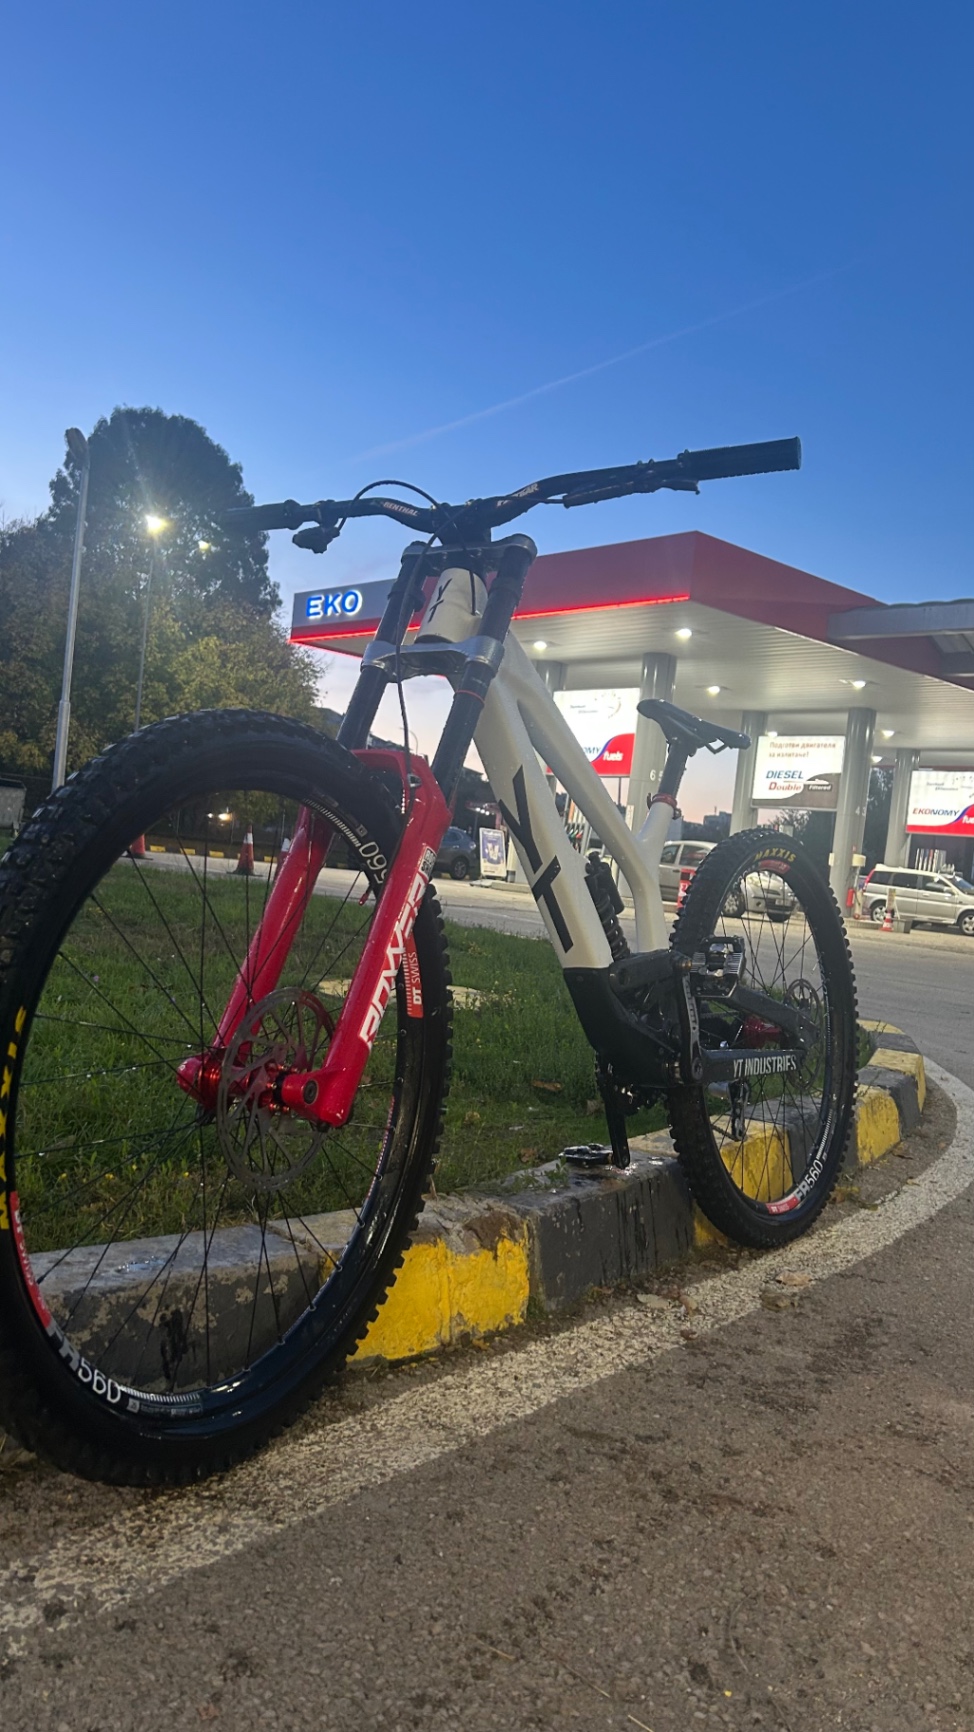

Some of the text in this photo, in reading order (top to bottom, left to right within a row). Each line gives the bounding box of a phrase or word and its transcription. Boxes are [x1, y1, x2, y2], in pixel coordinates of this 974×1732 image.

[306, 590, 361, 619] EKO
[766, 770, 804, 779] DIESEL
[769, 781, 801, 791] Double
[913, 808, 960, 816] EKONOMY
[753, 847, 797, 862] MAXXIS
[410, 951, 422, 1005] DT SWISS
